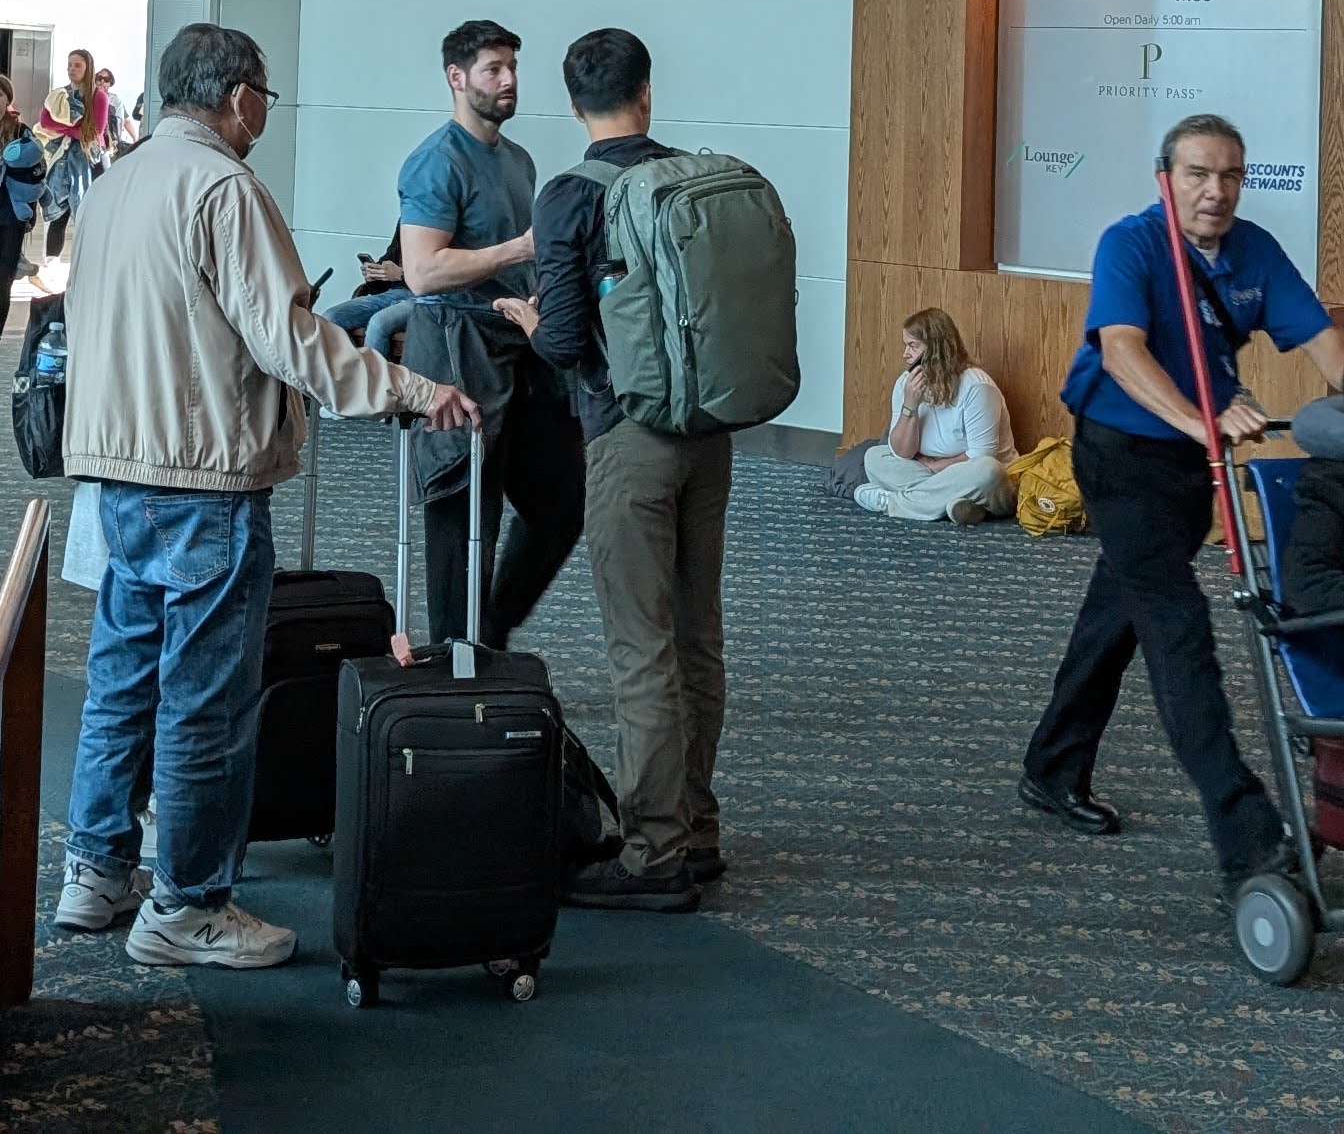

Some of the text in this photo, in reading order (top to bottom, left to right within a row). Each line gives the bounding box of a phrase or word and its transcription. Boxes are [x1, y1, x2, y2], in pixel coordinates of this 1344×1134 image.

[1104, 15, 1201, 27] Open Daily 5:00 am
[1098, 85, 1158, 98] PRIORITY
[1045, 164, 1064, 174] KEY
[1243, 162, 1306, 178] ISCOUNTS
[1241, 177, 1303, 192] REWARDS
